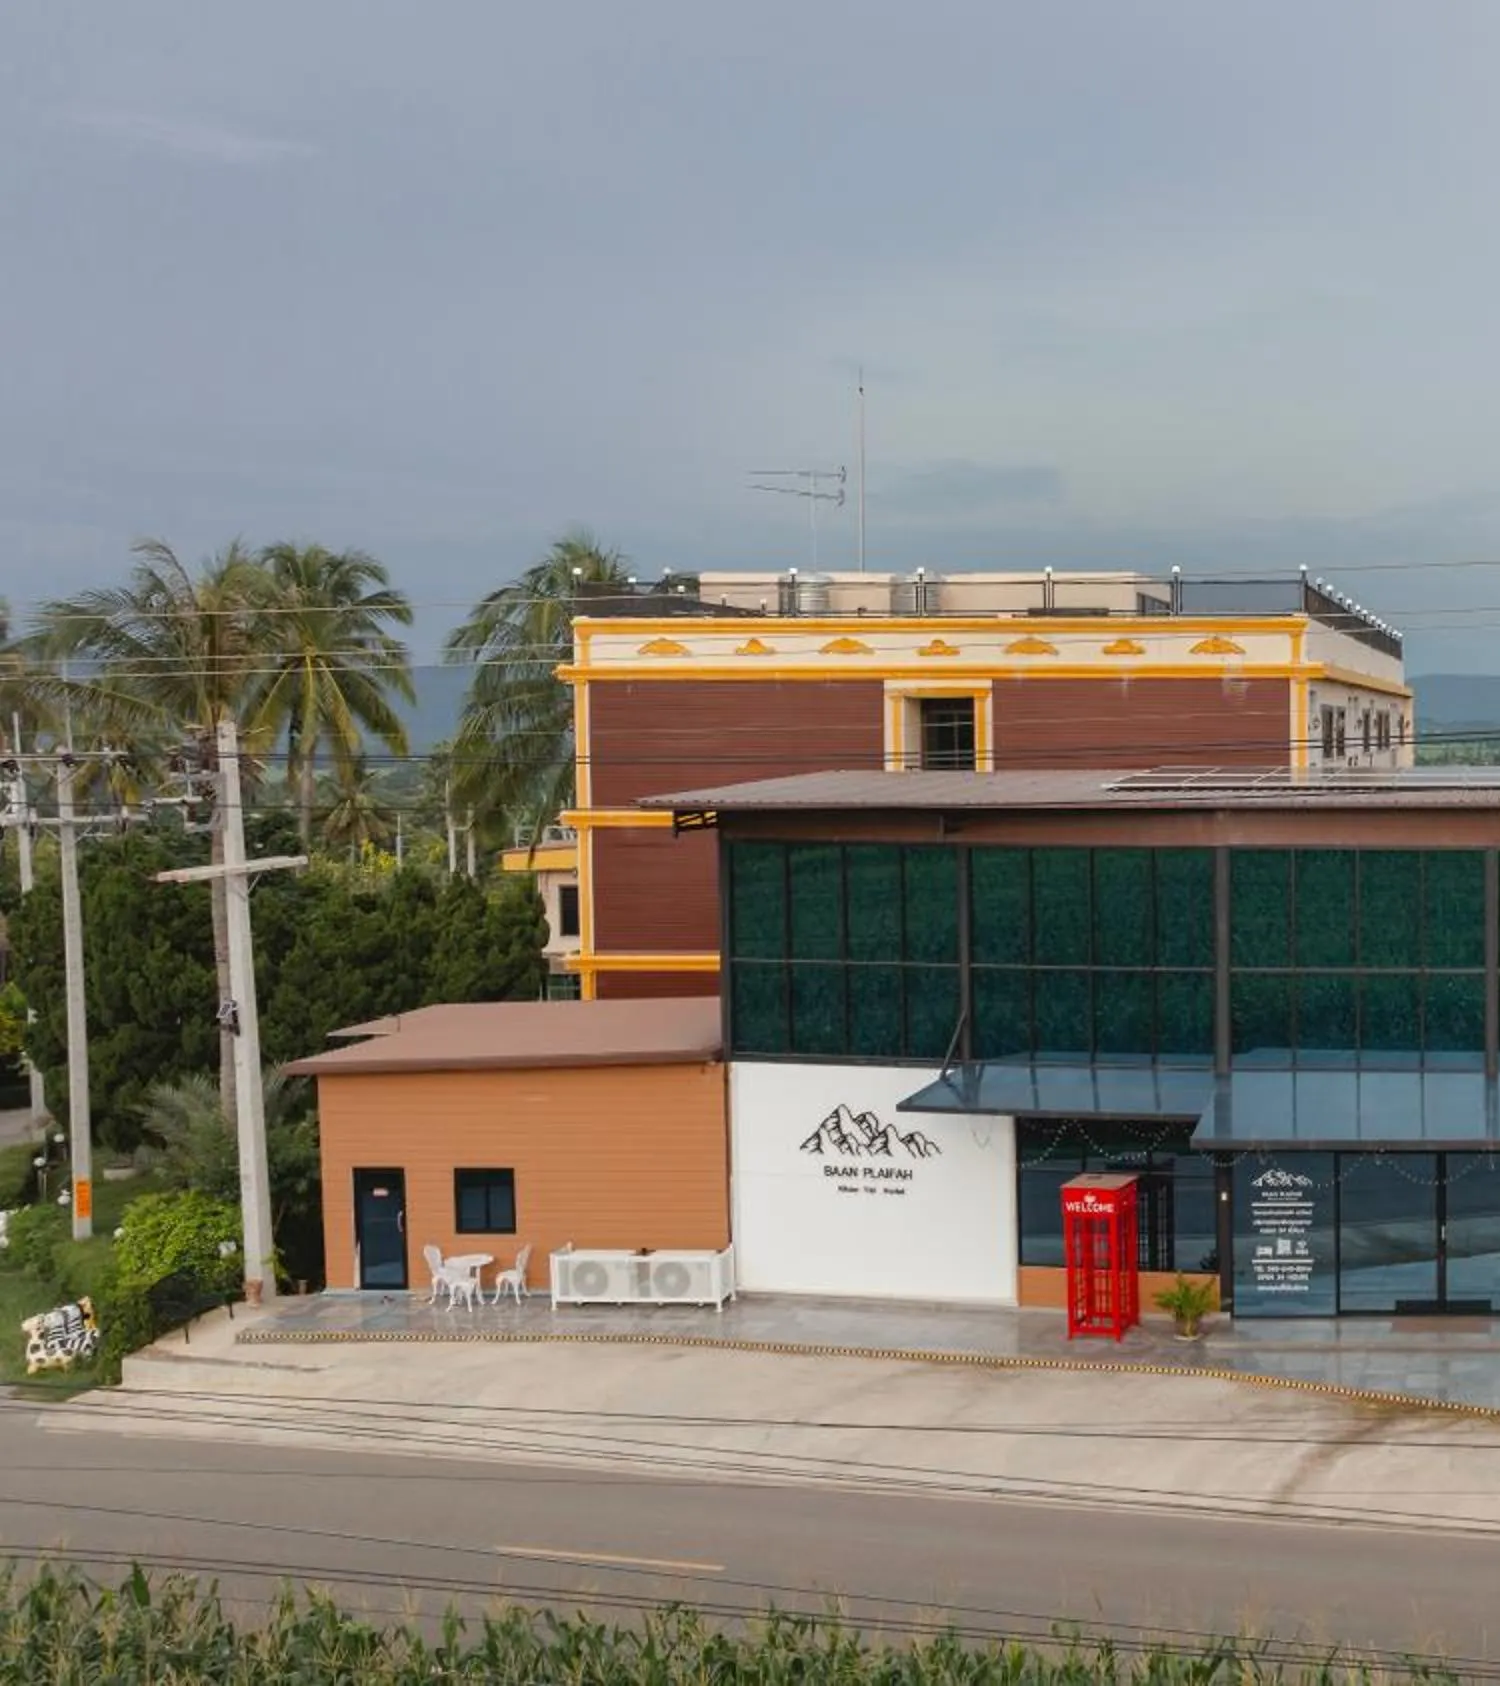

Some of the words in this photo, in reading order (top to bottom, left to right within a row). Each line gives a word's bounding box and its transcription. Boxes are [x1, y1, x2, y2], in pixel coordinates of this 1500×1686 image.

[824, 1165, 858, 1178] BAAN
[863, 1167, 913, 1180] PLAIFAH
[1065, 1202, 1114, 1213] WELCOME
